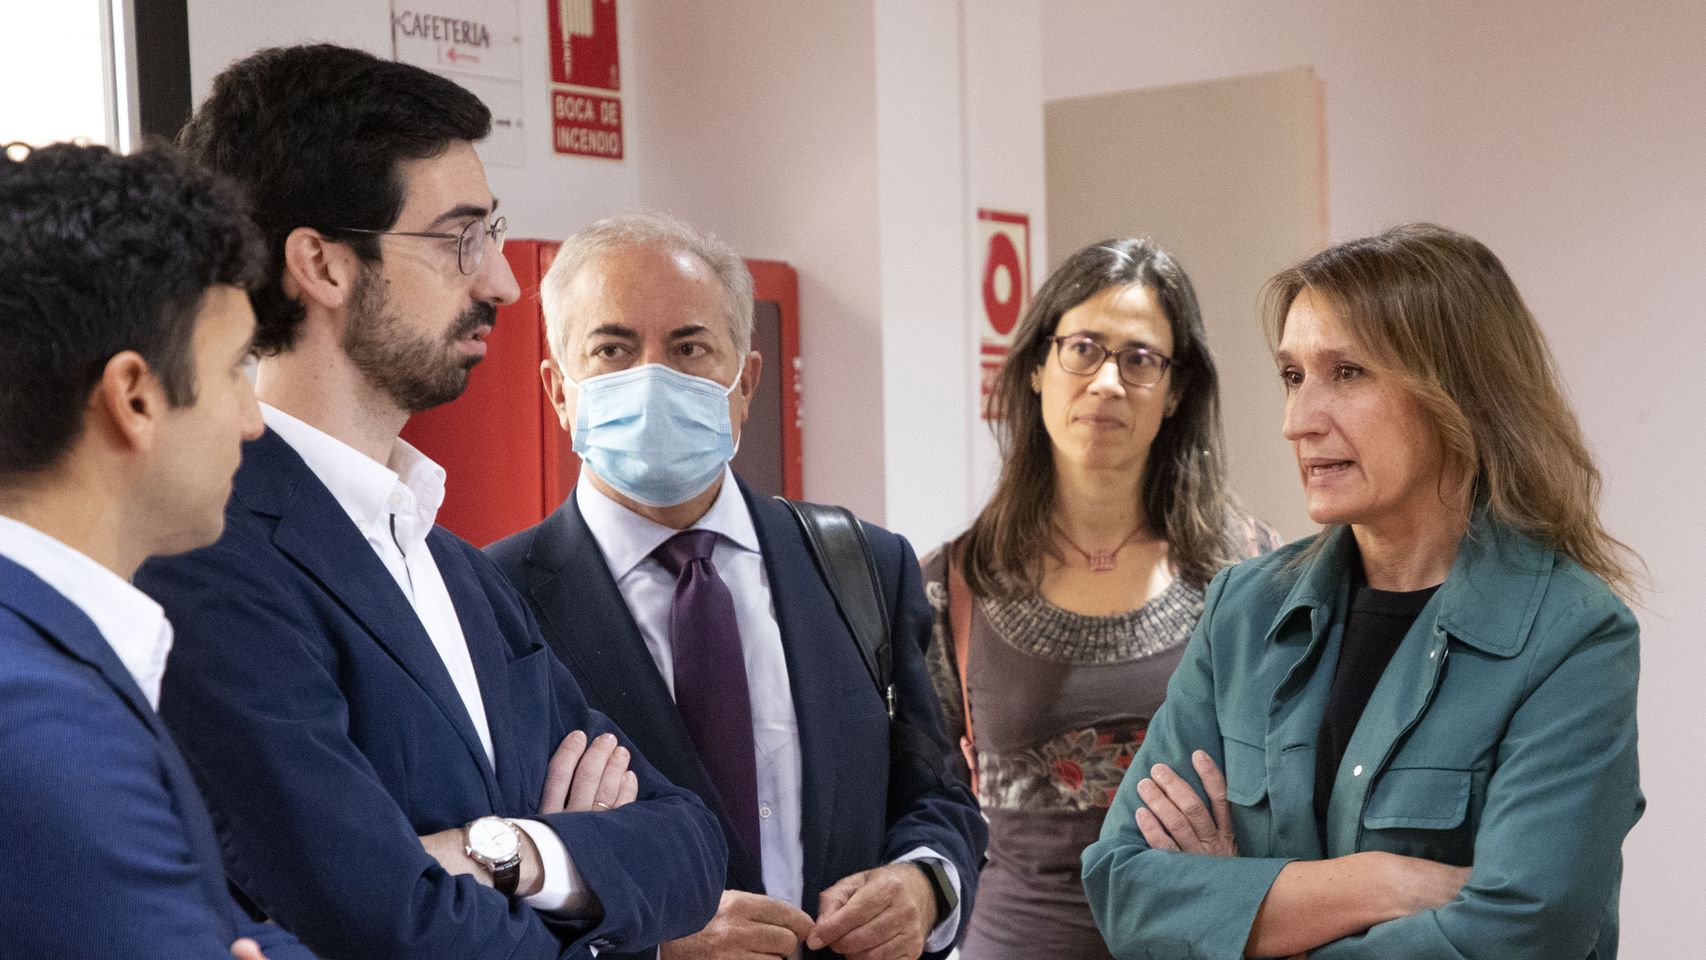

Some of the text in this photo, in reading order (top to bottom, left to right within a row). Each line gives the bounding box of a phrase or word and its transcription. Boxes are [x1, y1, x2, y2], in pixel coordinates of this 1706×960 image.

[555, 95, 618, 125] BOCA DE
[556, 126, 619, 154] INCENDIO
